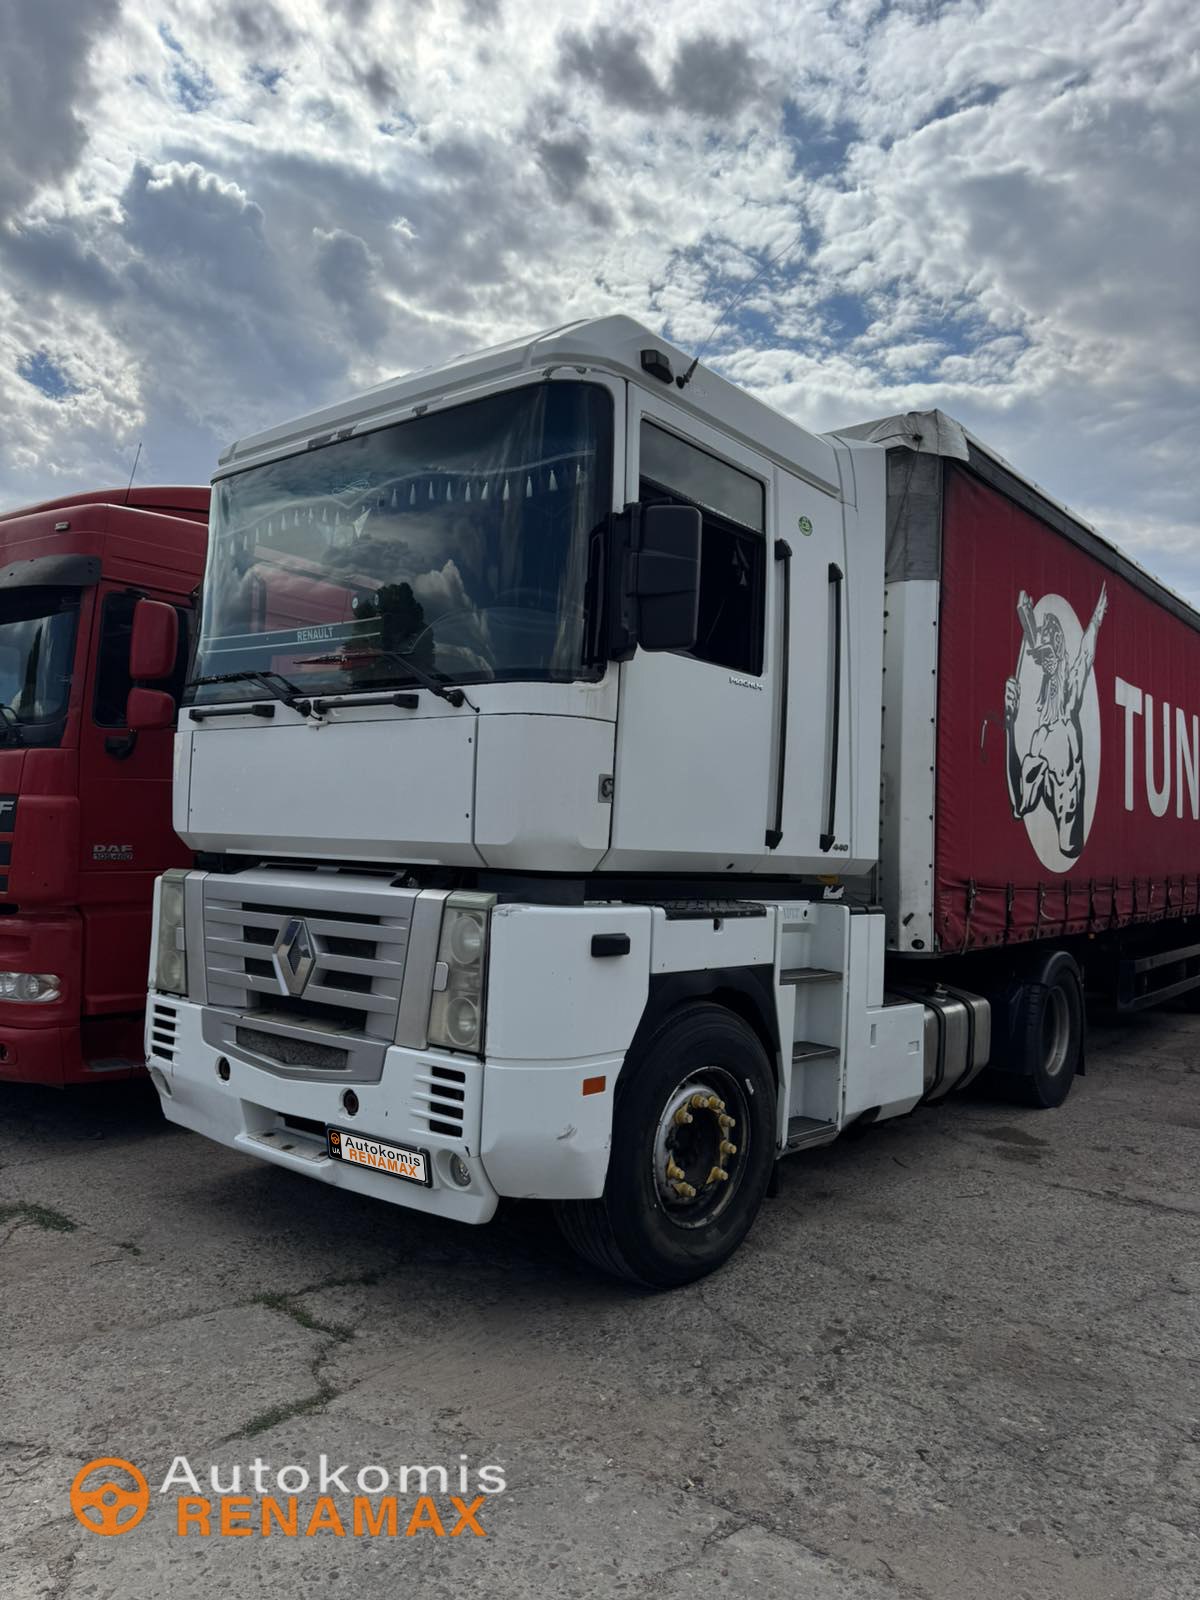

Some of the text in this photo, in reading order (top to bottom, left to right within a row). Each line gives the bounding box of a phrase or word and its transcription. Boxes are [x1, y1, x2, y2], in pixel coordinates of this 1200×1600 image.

[296, 627, 334, 643] RENAULT
[1115, 676, 1199, 820] TUN
[93, 844, 133, 852] DAF
